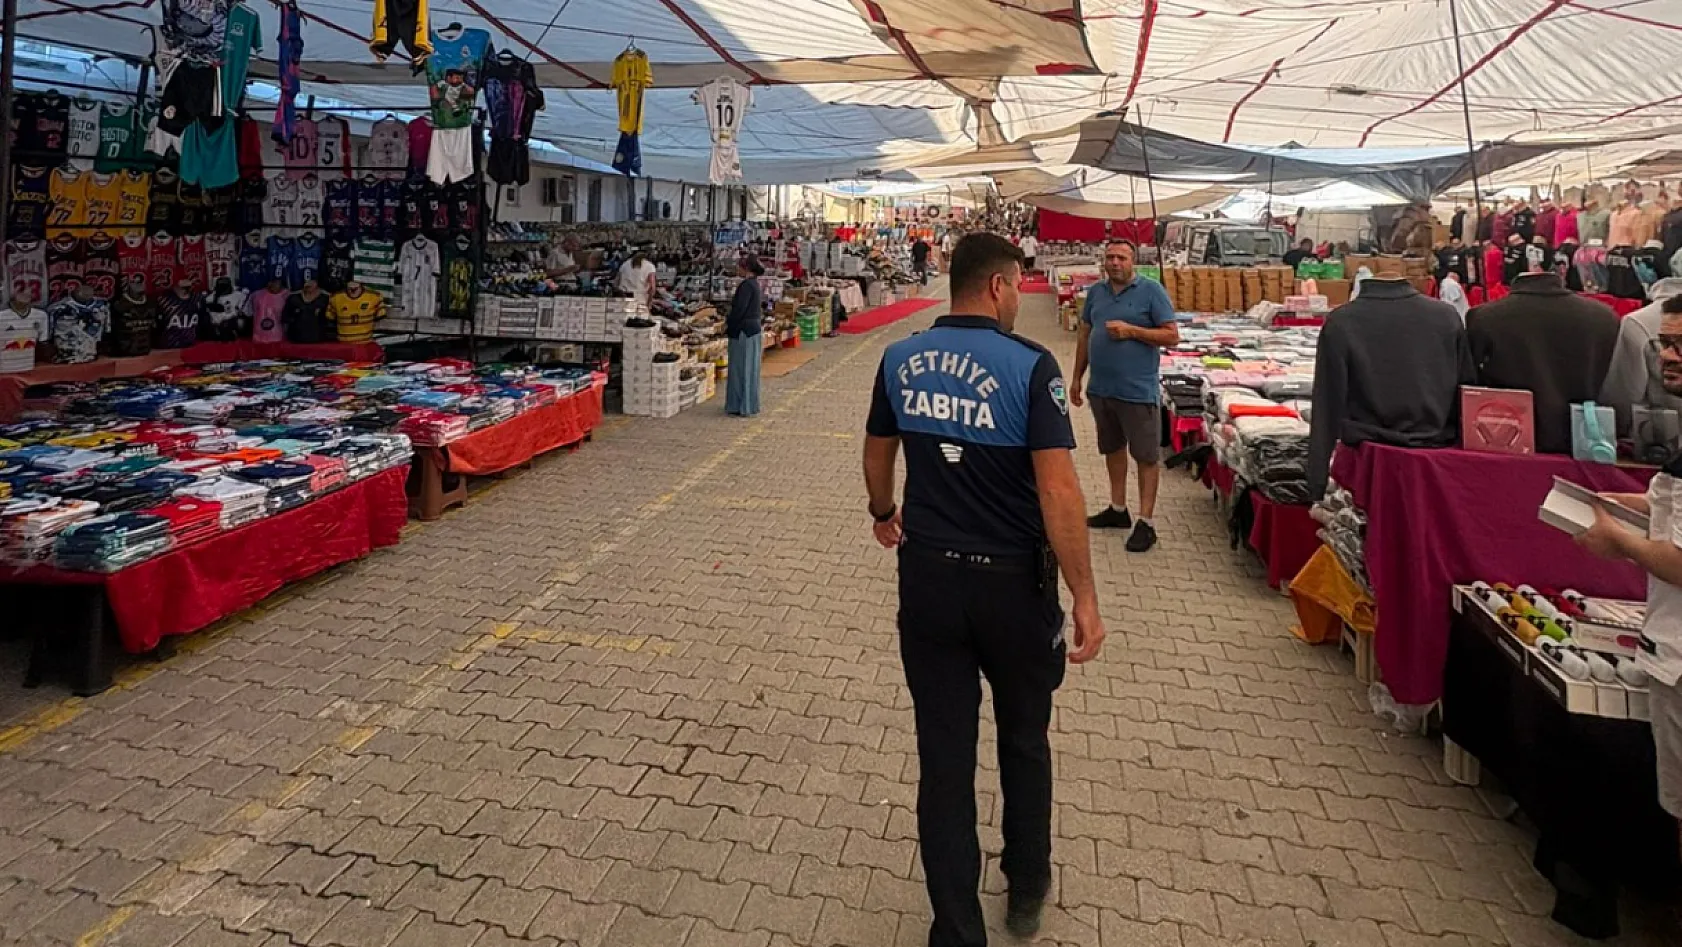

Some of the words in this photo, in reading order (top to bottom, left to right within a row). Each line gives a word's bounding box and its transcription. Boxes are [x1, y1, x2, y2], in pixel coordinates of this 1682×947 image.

[716, 104, 734, 127] 10
[107, 142, 120, 158] 0
[322, 141, 334, 165] 5
[120, 206, 137, 220] 23
[212, 262, 228, 278] 21
[414, 264, 421, 280] 7
[897, 350, 1000, 400] FETHİYE
[901, 388, 996, 430] ZABITA
[945, 550, 992, 565] ZAITA
